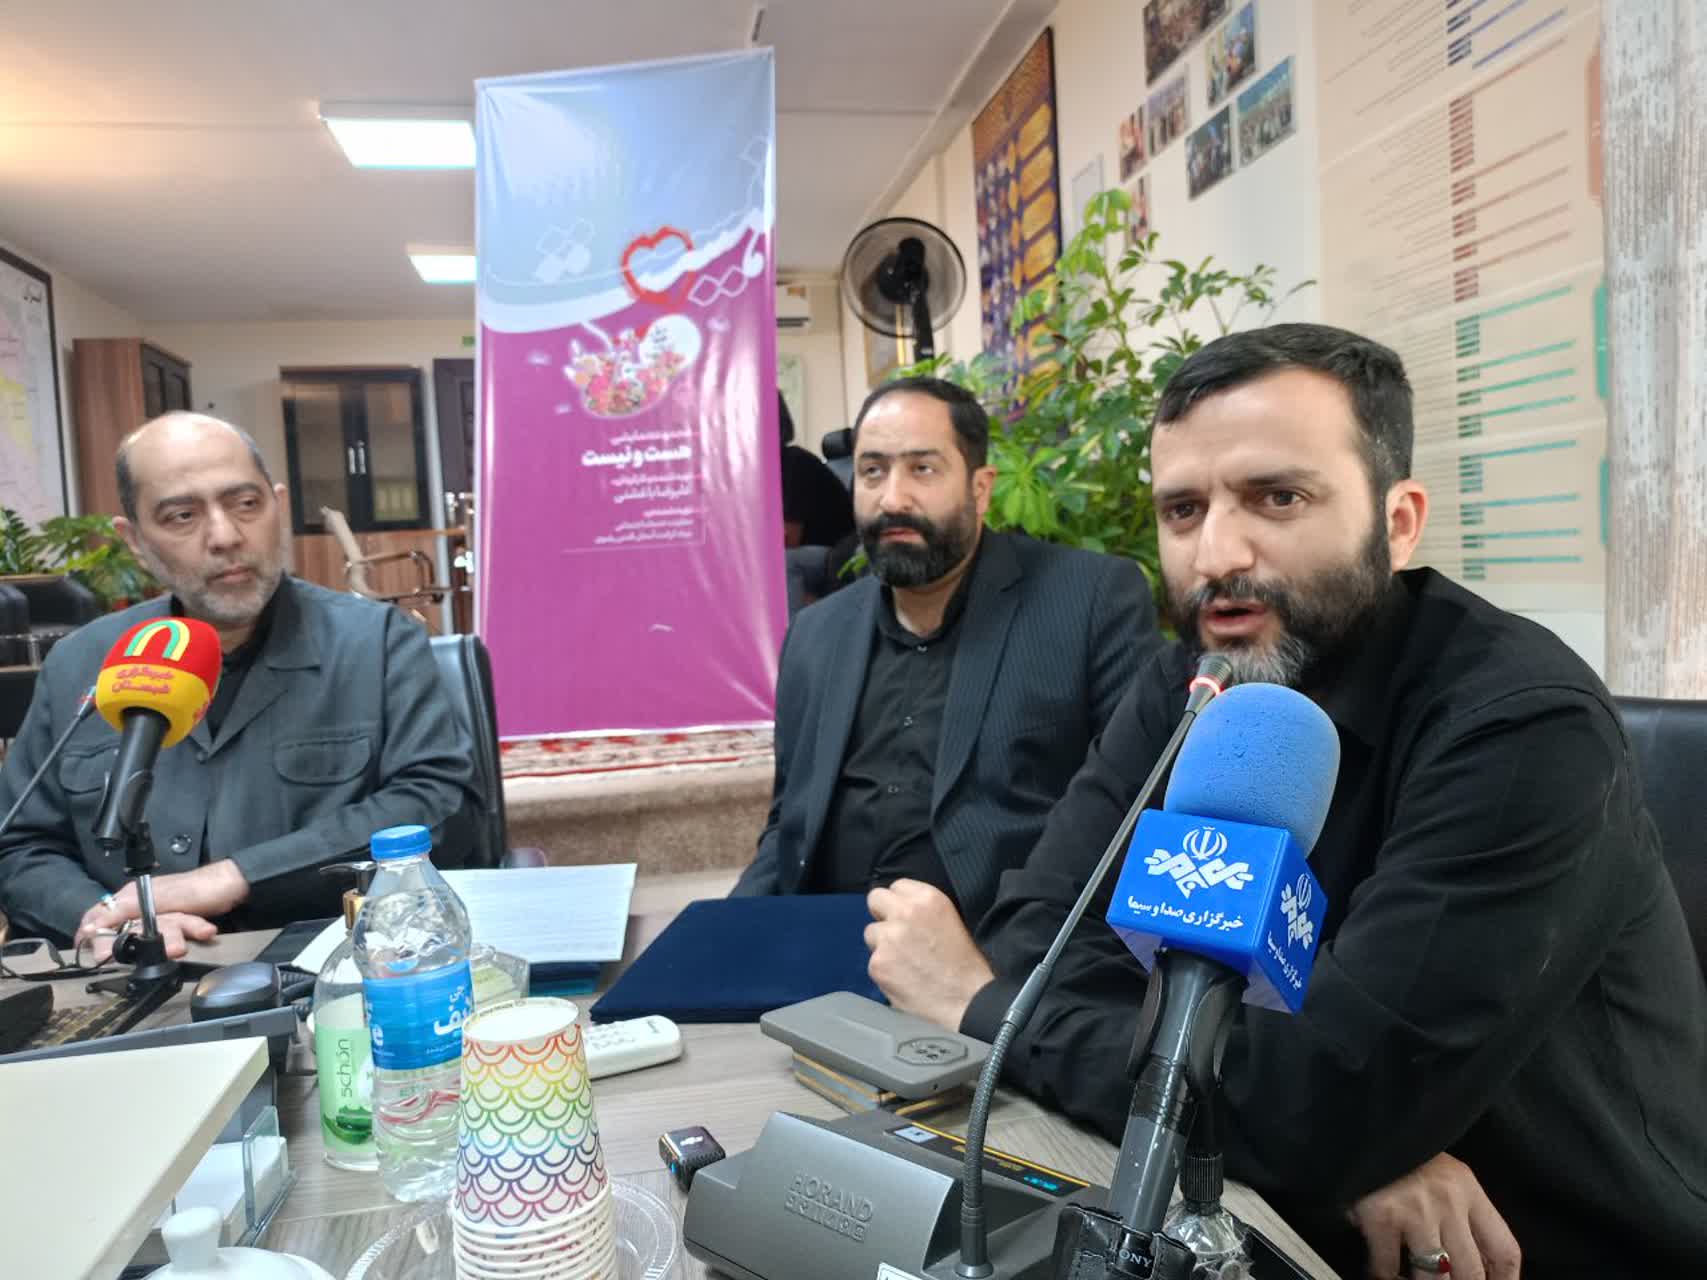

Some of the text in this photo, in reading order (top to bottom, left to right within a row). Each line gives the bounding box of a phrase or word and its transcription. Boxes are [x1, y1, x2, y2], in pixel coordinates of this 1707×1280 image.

[1127, 895, 1244, 932] خبرگزاری صدا و سیما
[1117, 1248, 1152, 1268] ONY
